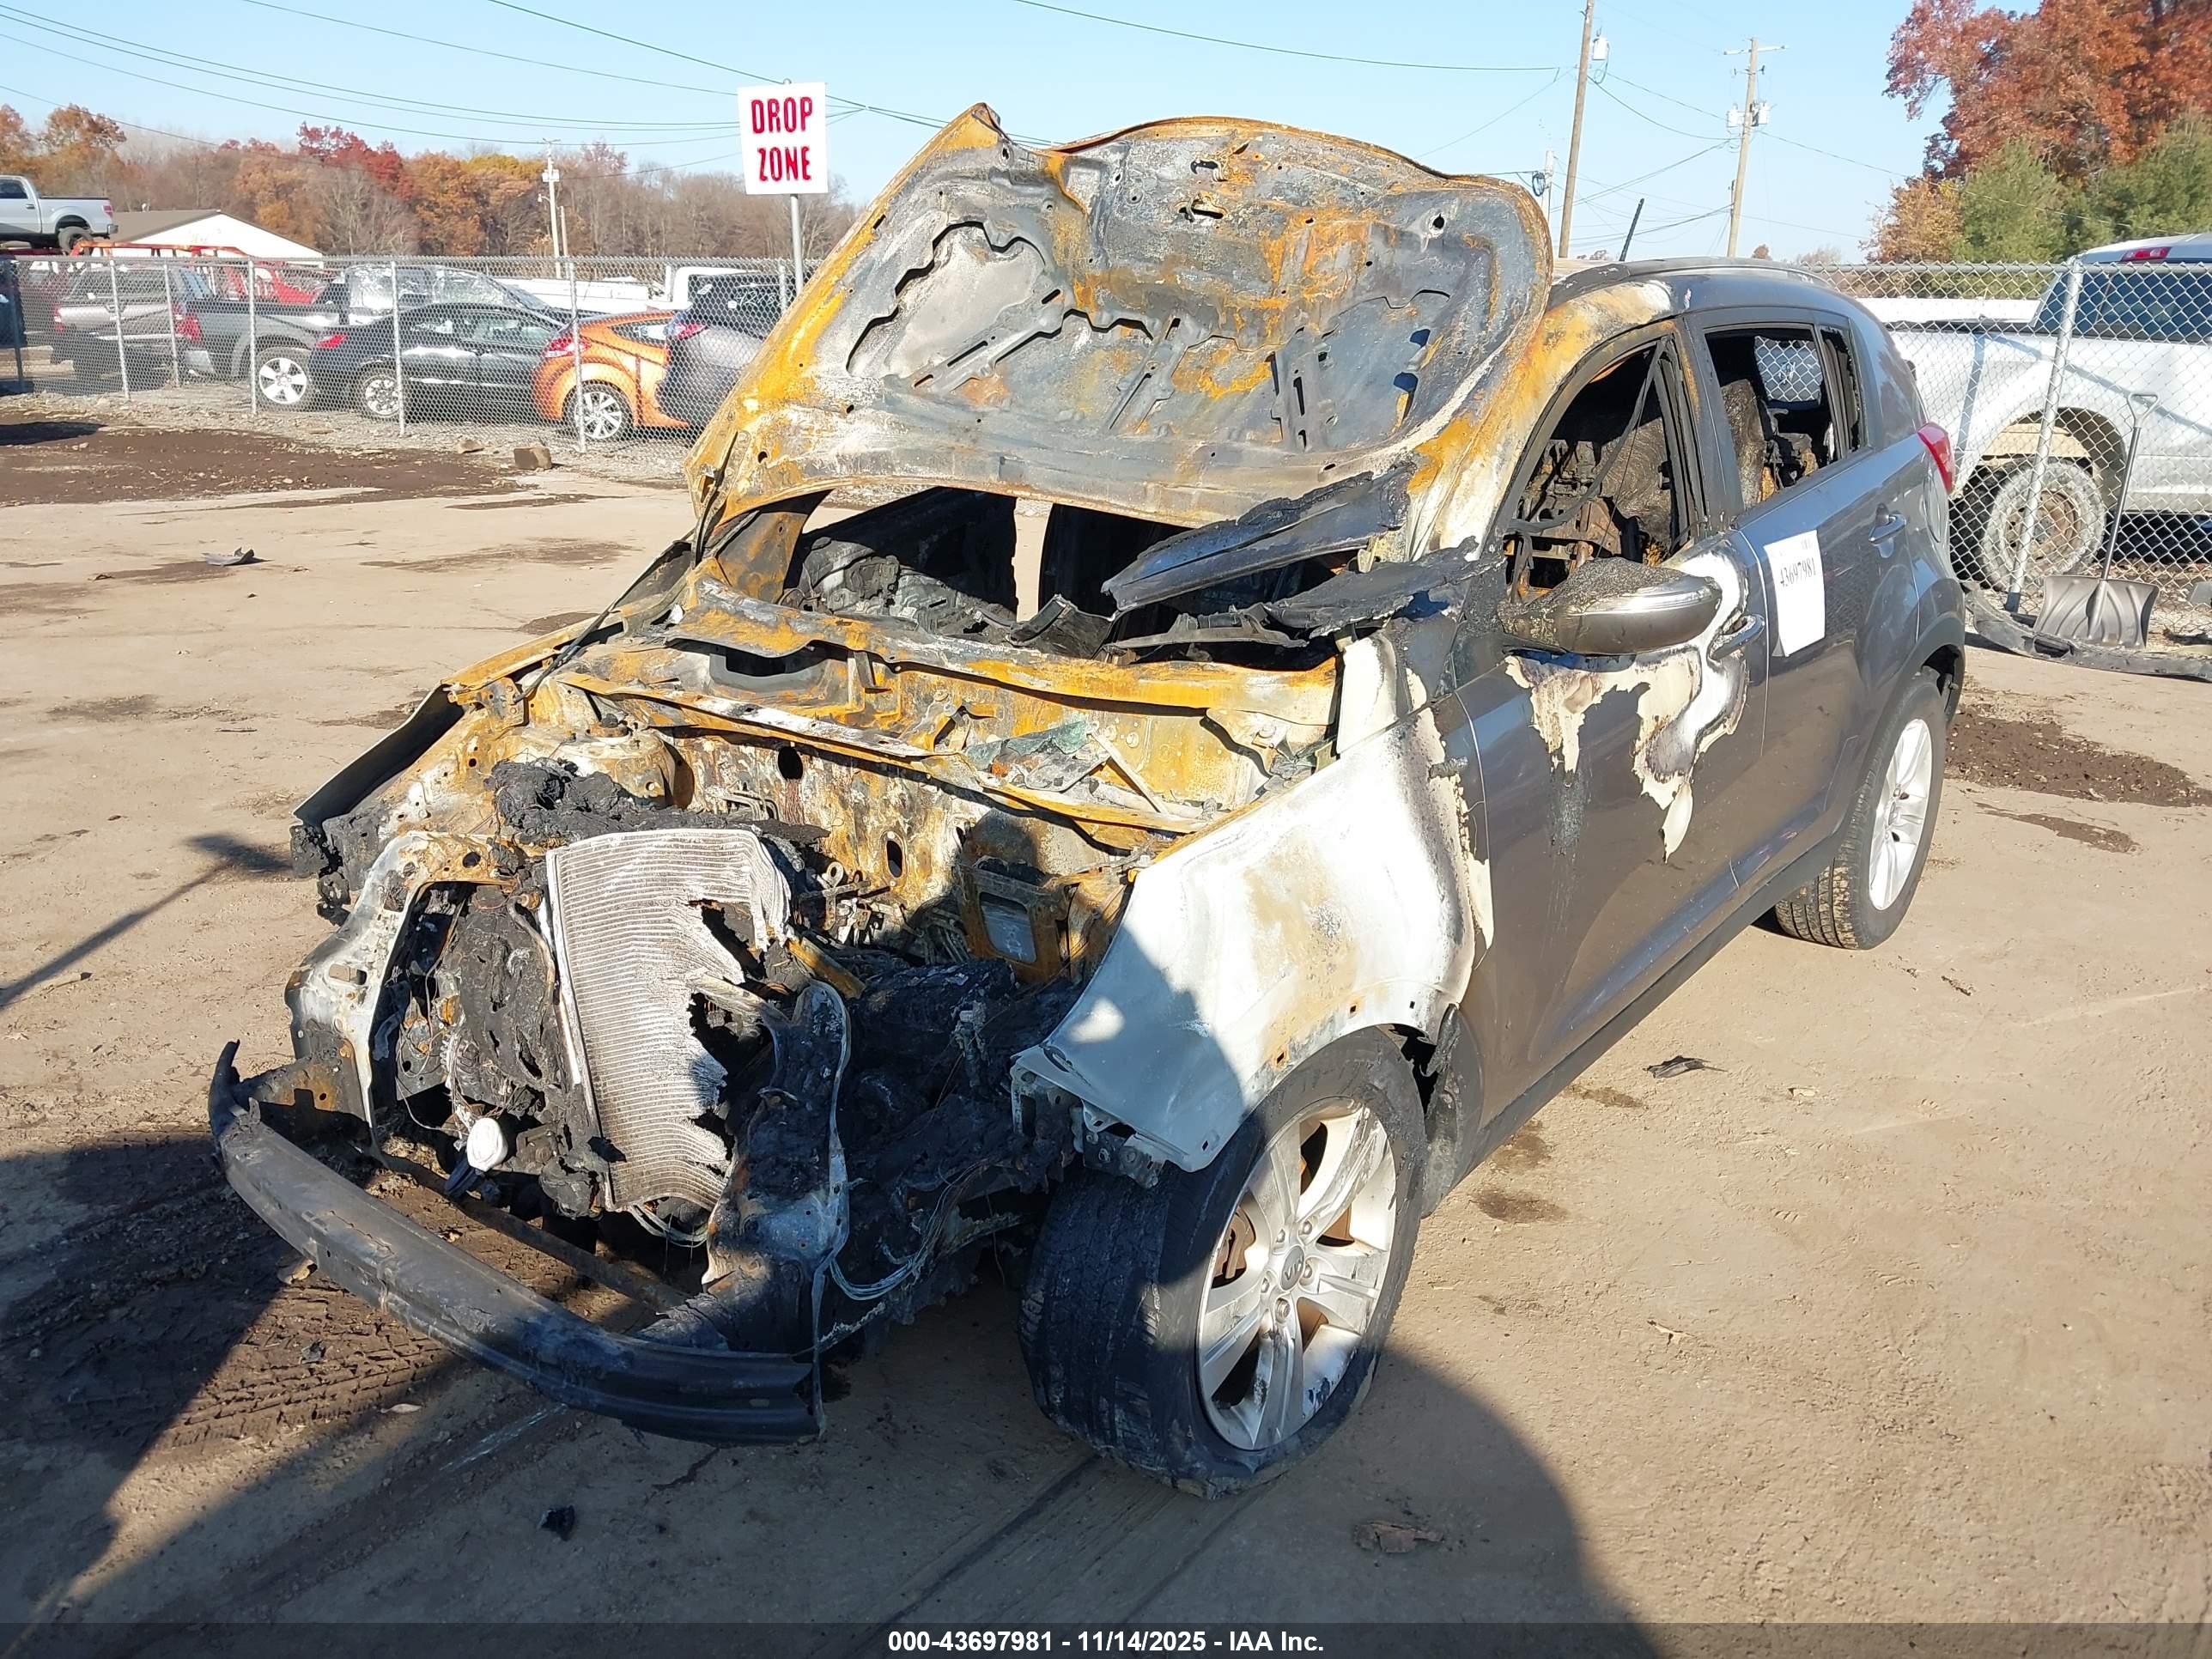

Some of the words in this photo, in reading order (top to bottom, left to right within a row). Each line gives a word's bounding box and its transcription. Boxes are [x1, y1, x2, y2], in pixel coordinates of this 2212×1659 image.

[750, 96, 812, 134] DROP
[757, 145, 811, 182] ZONE
[1779, 556, 1817, 588] 43697981
